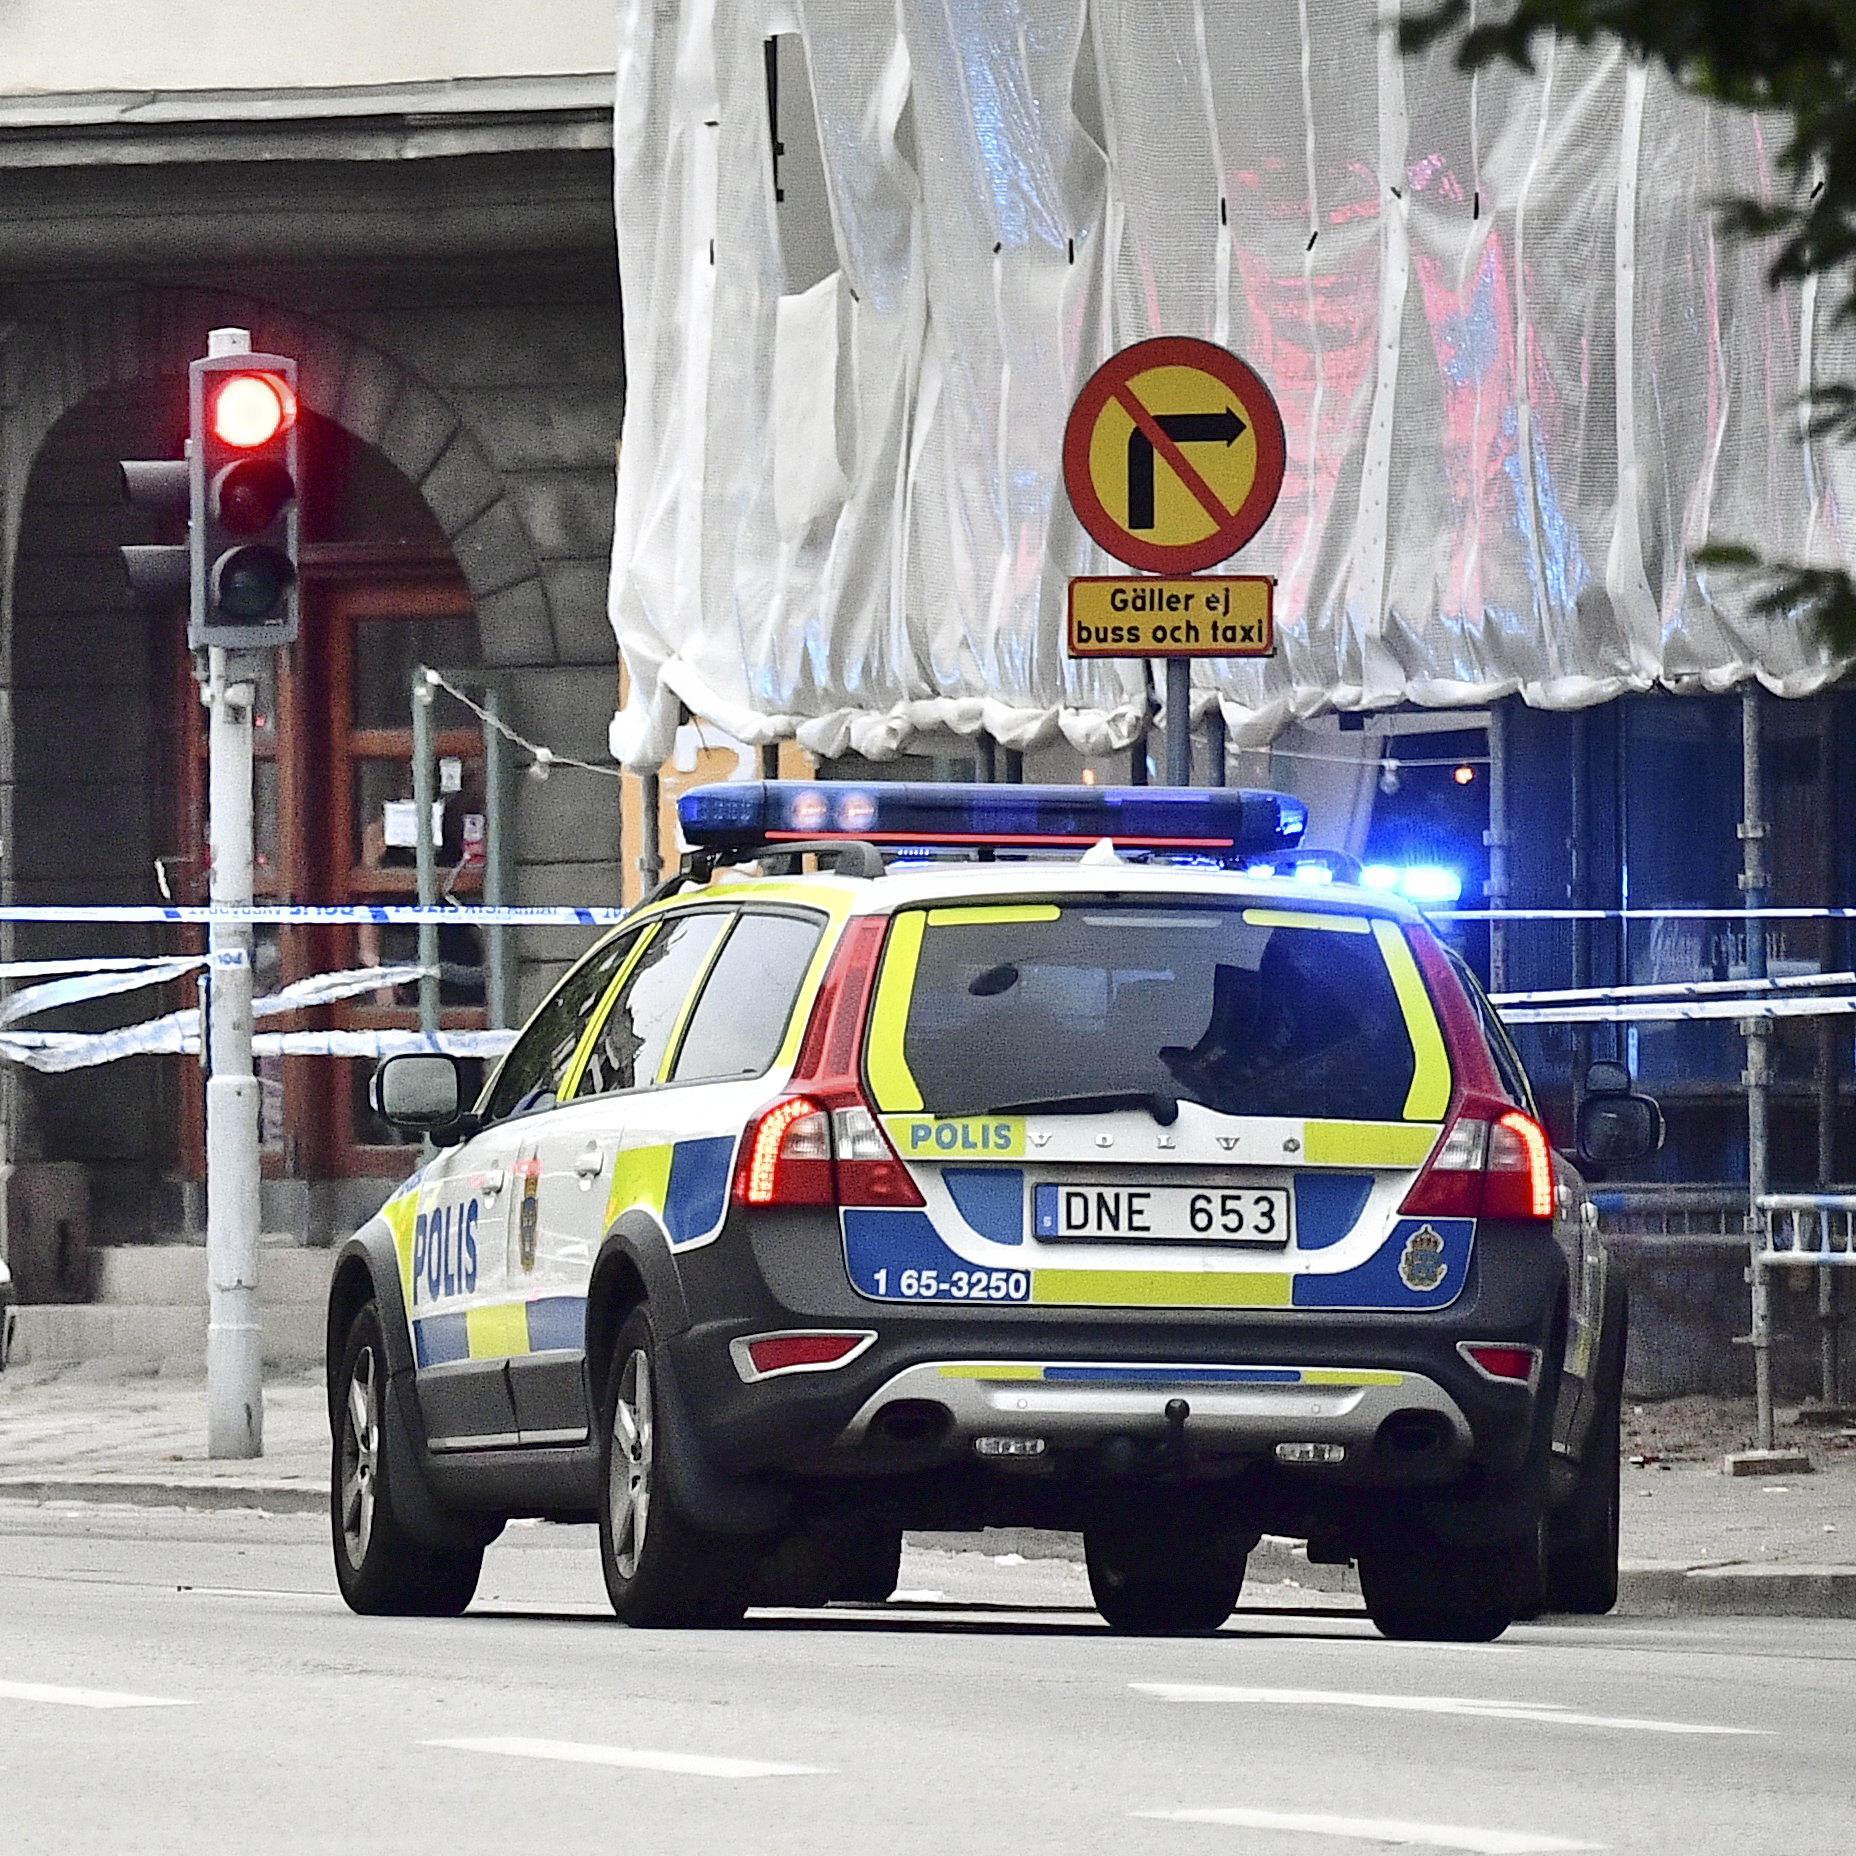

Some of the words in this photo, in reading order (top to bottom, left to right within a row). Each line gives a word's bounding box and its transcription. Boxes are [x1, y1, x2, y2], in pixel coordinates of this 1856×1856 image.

[1110, 587, 1194, 612] Gäller
[1205, 587, 1231, 617] ej
[1076, 620, 1141, 643] buss
[1152, 619, 1199, 643] och
[1211, 618, 1263, 643] taxi
[910, 1122, 1012, 1150] POLIS
[1065, 1191, 1152, 1232] DNE
[1189, 1194, 1276, 1235] 653
[413, 1197, 479, 1306] POLIS
[873, 1268, 888, 1295] 1
[899, 1268, 1028, 1299] 65-3250
